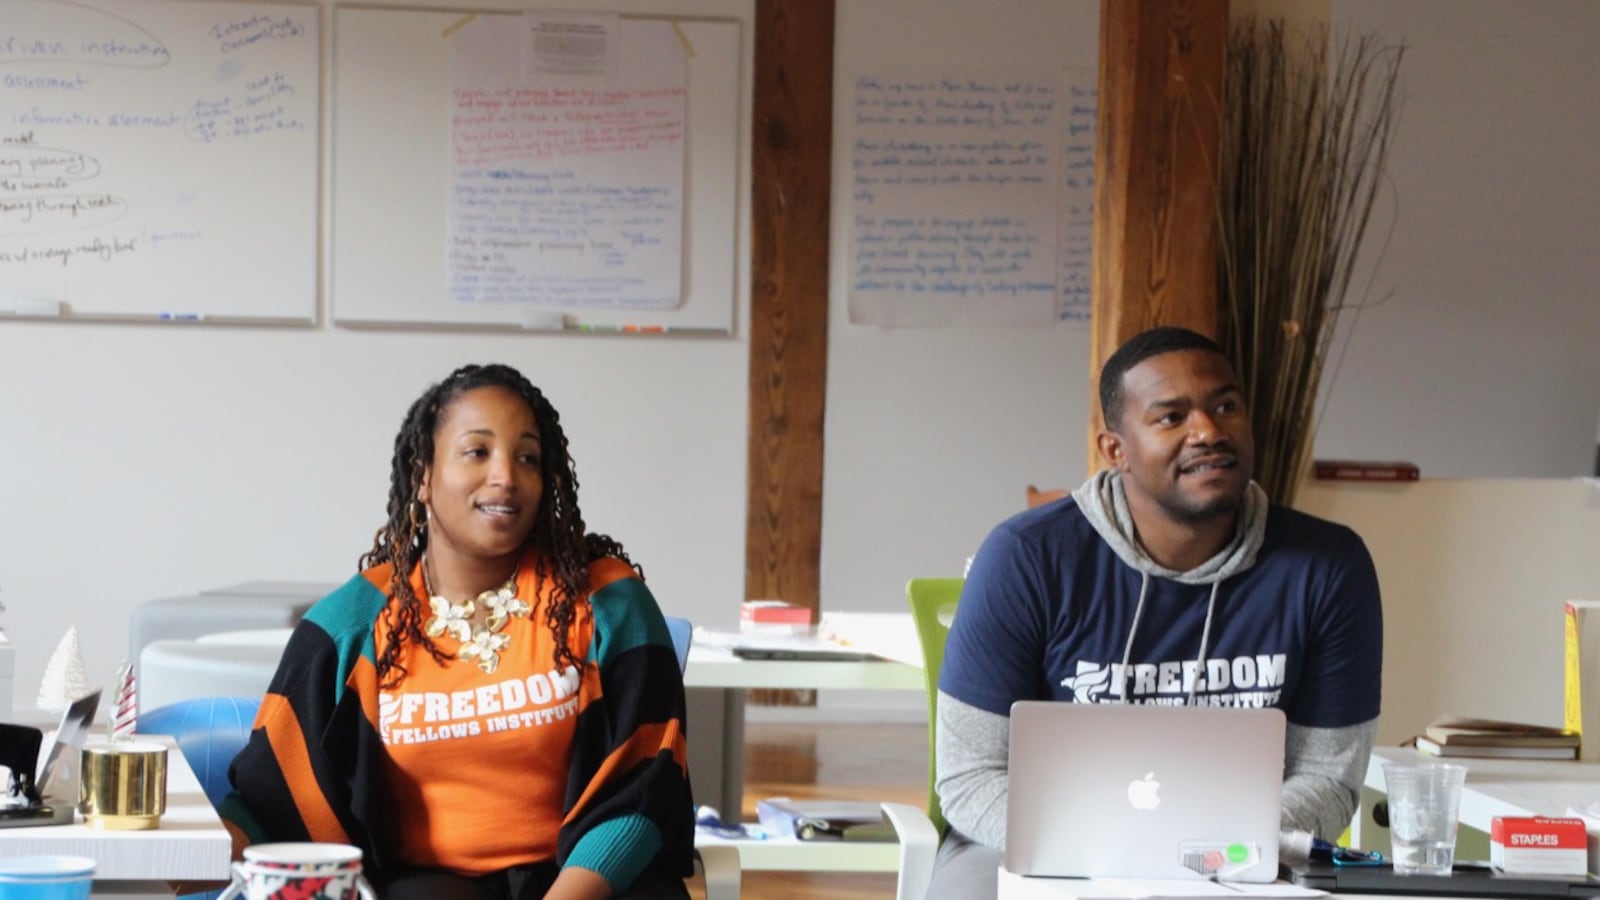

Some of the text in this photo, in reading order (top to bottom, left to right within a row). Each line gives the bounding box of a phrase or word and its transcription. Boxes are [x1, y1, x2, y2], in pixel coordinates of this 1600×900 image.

[1108, 653, 1287, 696] FREEDOM
[399, 665, 580, 725] FREEDOM
[391, 720, 481, 745] FELLOWS
[1511, 834, 1558, 845] STAPLES
